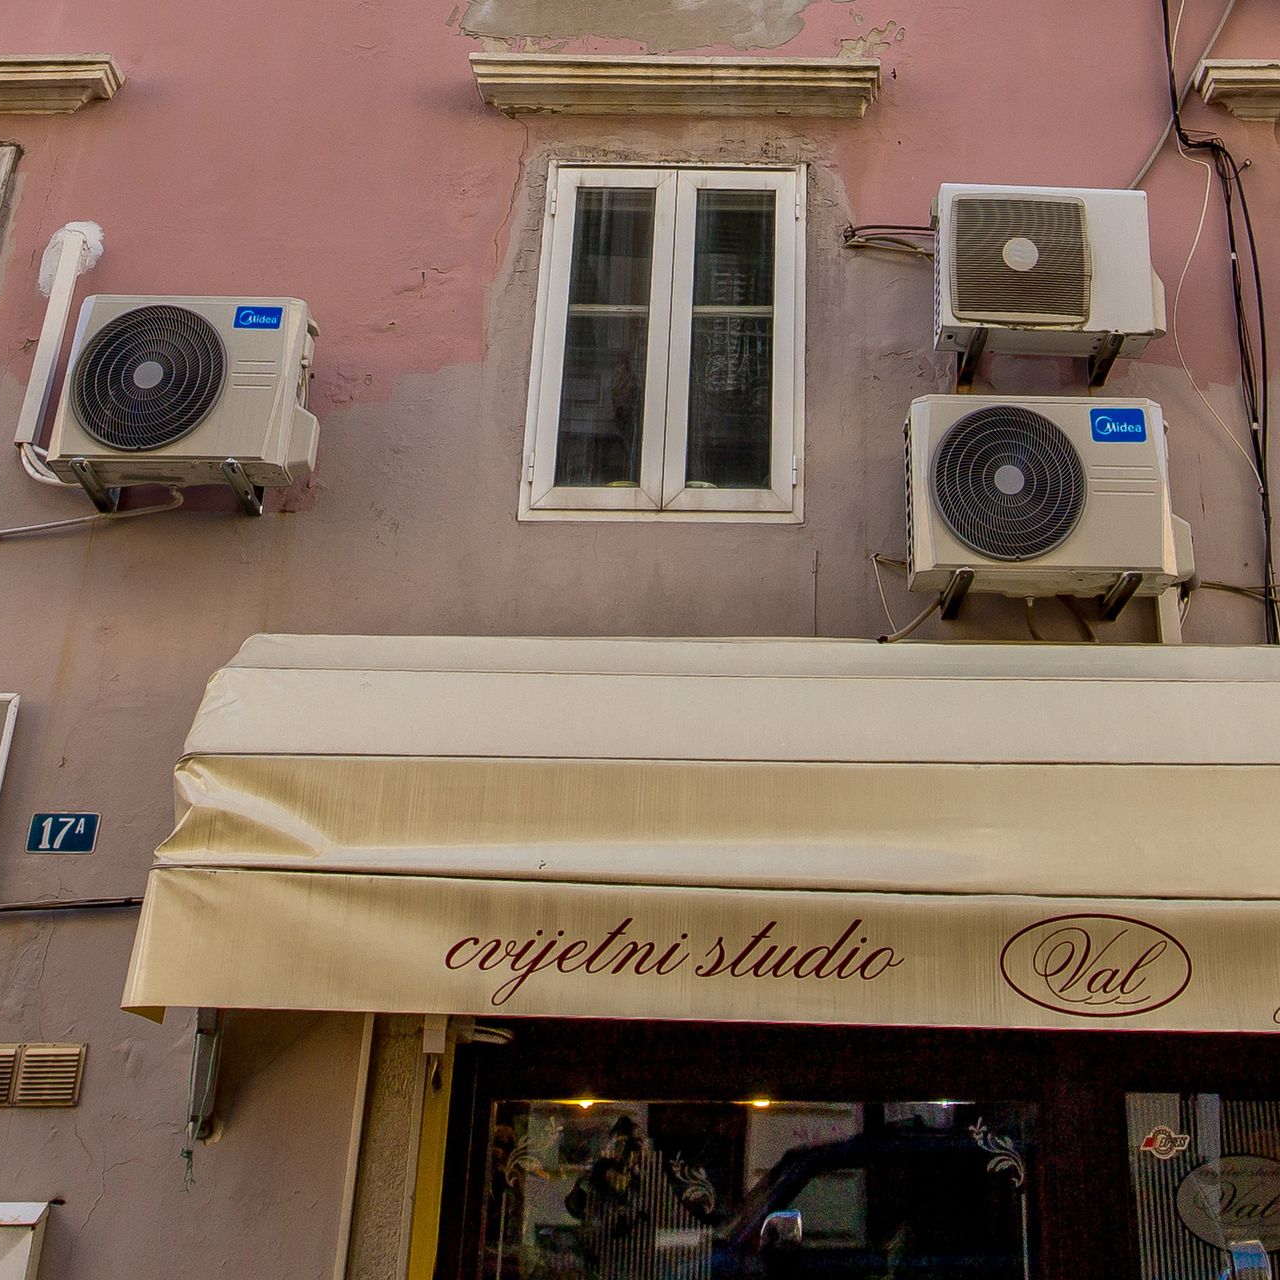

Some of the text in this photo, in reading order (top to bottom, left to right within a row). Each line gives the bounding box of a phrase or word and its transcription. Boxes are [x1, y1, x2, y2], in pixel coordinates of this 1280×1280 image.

[239, 310, 278, 326] Midea
[1095, 416, 1142, 435] Midea
[446, 916, 904, 1007] cvijetni studio
[1033, 926, 1152, 1006] Val
